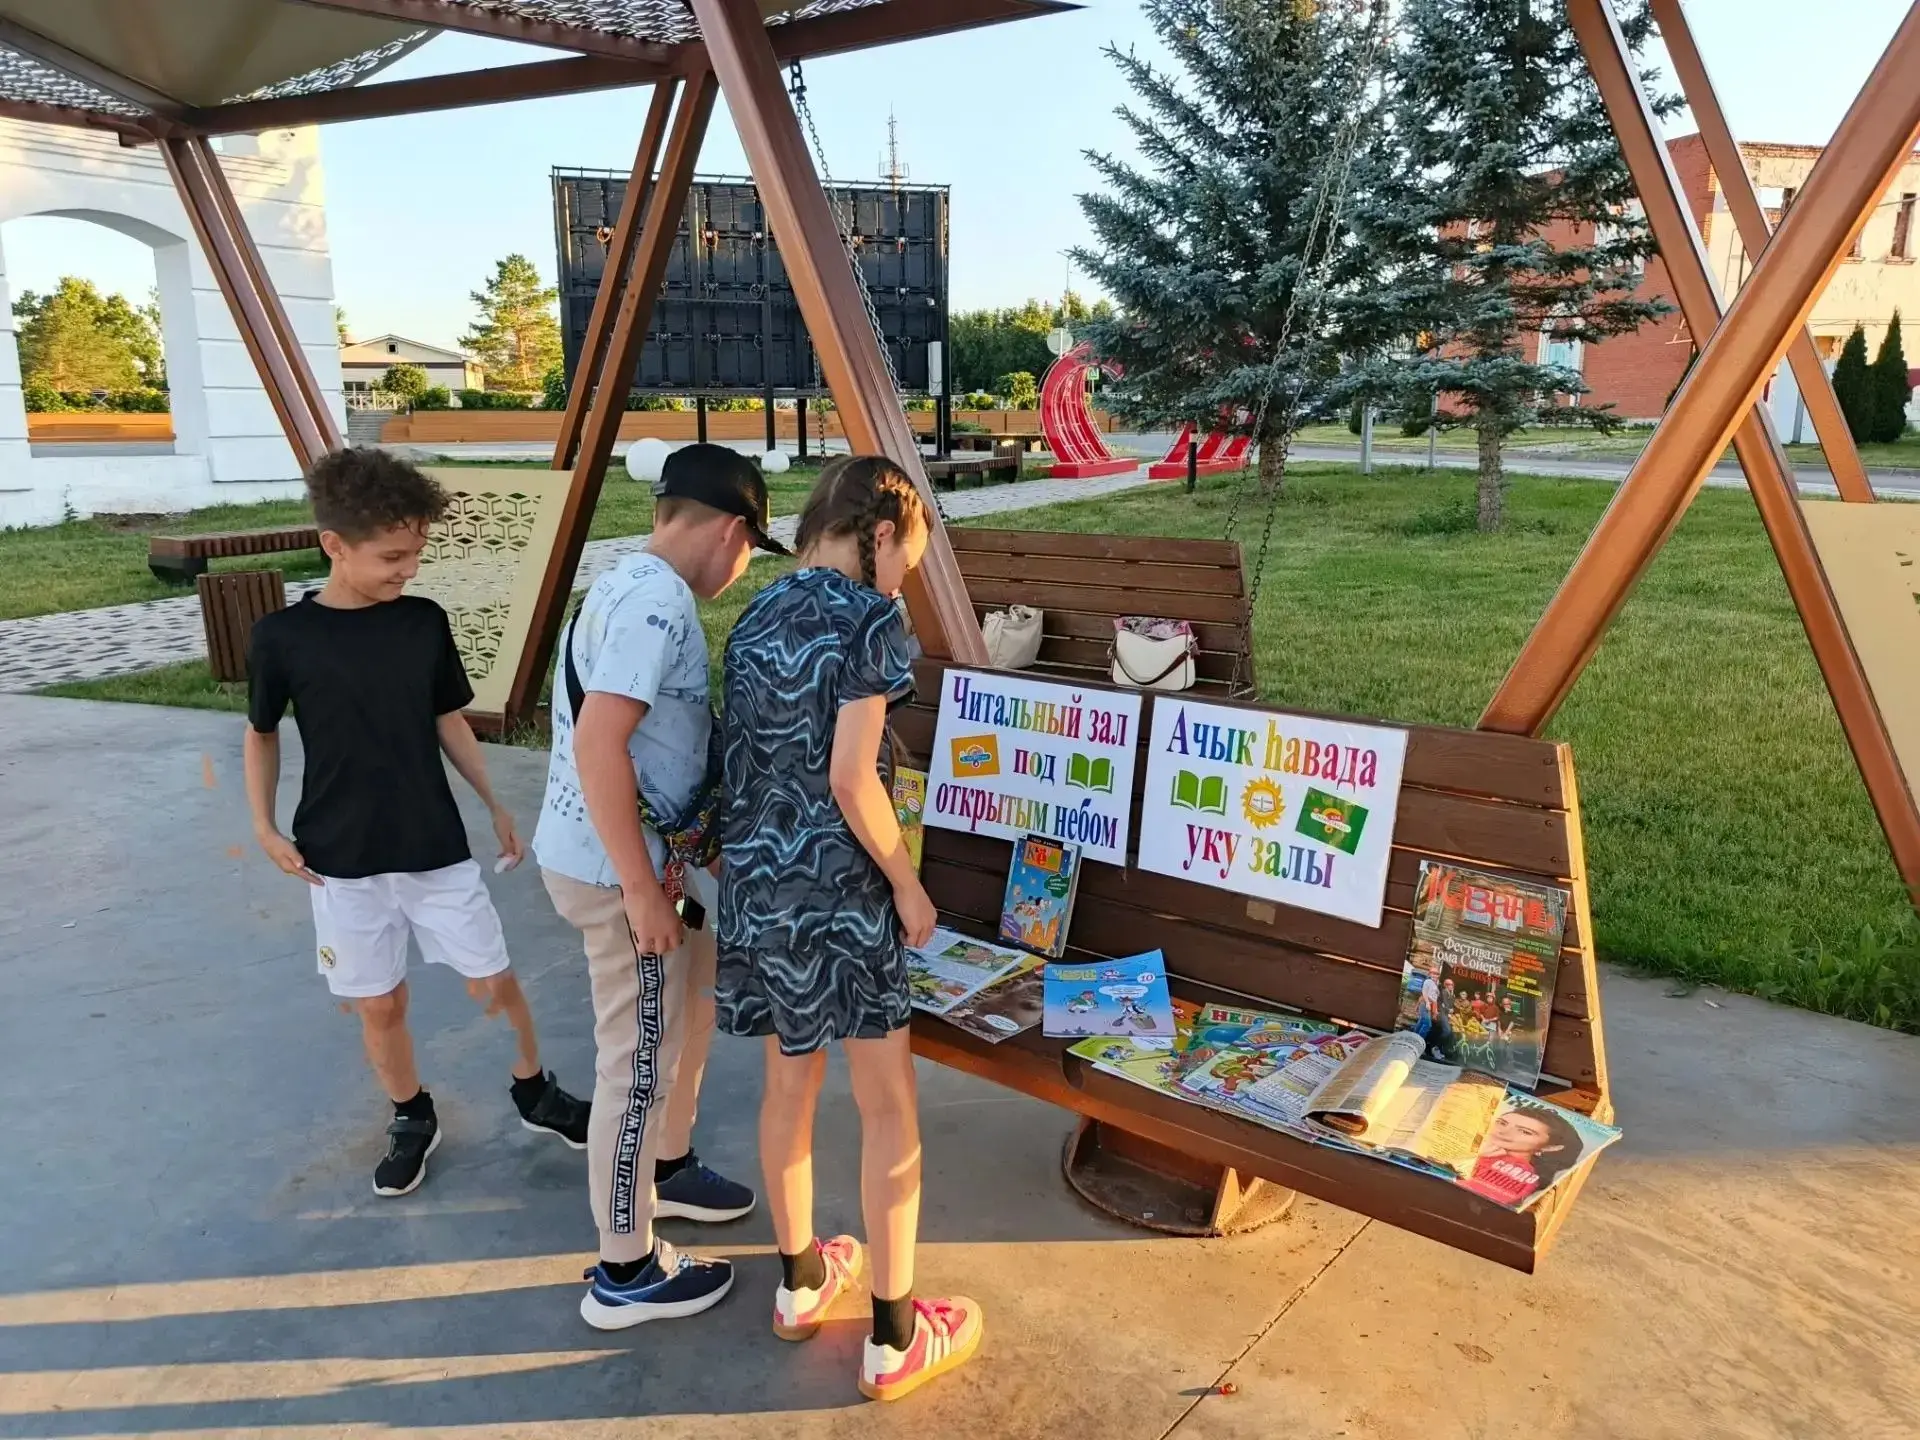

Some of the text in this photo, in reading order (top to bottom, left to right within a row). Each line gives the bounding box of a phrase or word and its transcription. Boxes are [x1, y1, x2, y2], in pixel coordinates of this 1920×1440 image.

[953, 676, 1128, 747] Читальный зал
[1166, 705, 1257, 767] Ачык
[1013, 749, 1056, 786] под
[936, 782, 1119, 849] открытым небом
[1183, 823, 1336, 889] уку залы
[1431, 945, 1458, 964] Тома
[1460, 953, 1502, 976] Сойера
[1443, 936, 1504, 963] Фестиваль
[620, 1131, 636, 1162] NEW
